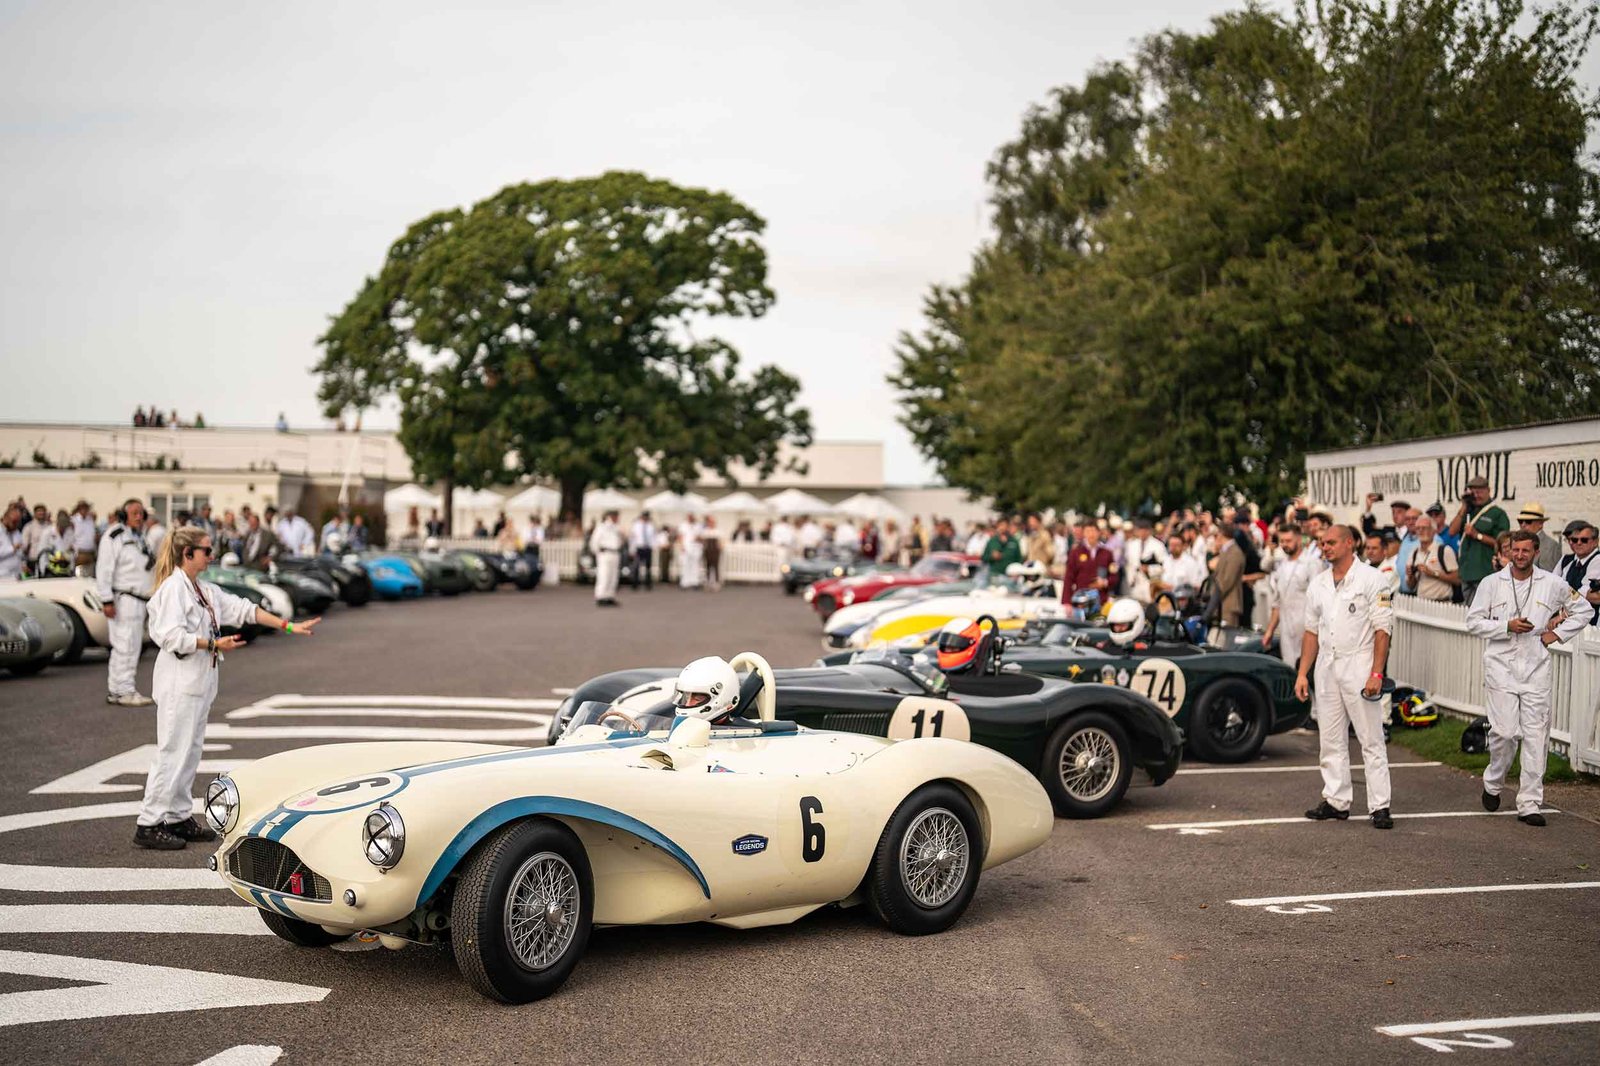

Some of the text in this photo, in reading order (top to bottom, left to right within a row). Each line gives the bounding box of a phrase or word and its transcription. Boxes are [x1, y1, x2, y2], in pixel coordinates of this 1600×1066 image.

[1310, 466, 1359, 505] MOTUL
[1402, 470, 1421, 493] OILS
[1437, 451, 1516, 503] MOTUL
[1536, 460, 1586, 488] MOTOR
[1142, 670, 1176, 710] 74
[911, 709, 944, 738] 11
[317, 777, 391, 796] 6
[800, 796, 826, 863] 6
[735, 842, 765, 851] LEGENDS
[1410, 1033, 1514, 1053] 2
